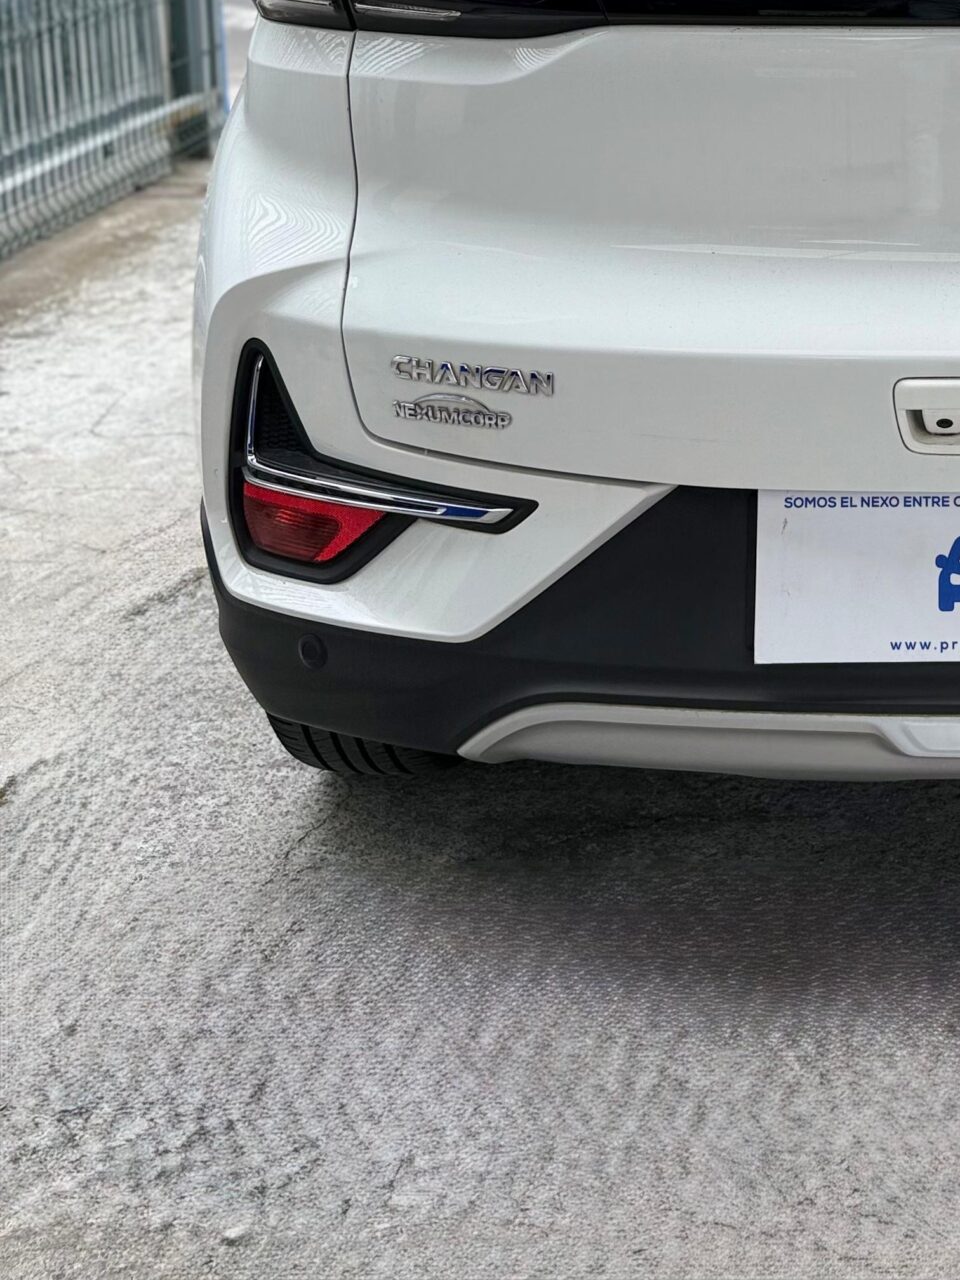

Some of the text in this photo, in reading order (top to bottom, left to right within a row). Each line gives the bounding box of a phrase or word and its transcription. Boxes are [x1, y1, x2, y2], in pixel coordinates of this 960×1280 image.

[391, 354, 555, 397] CHANGAN
[392, 399, 513, 430] NEXUMCORP
[784, 496, 837, 509] SOMOS
[840, 496, 857, 508] EL
[860, 496, 900, 508] NEXO
[903, 495, 950, 508] ENTRE
